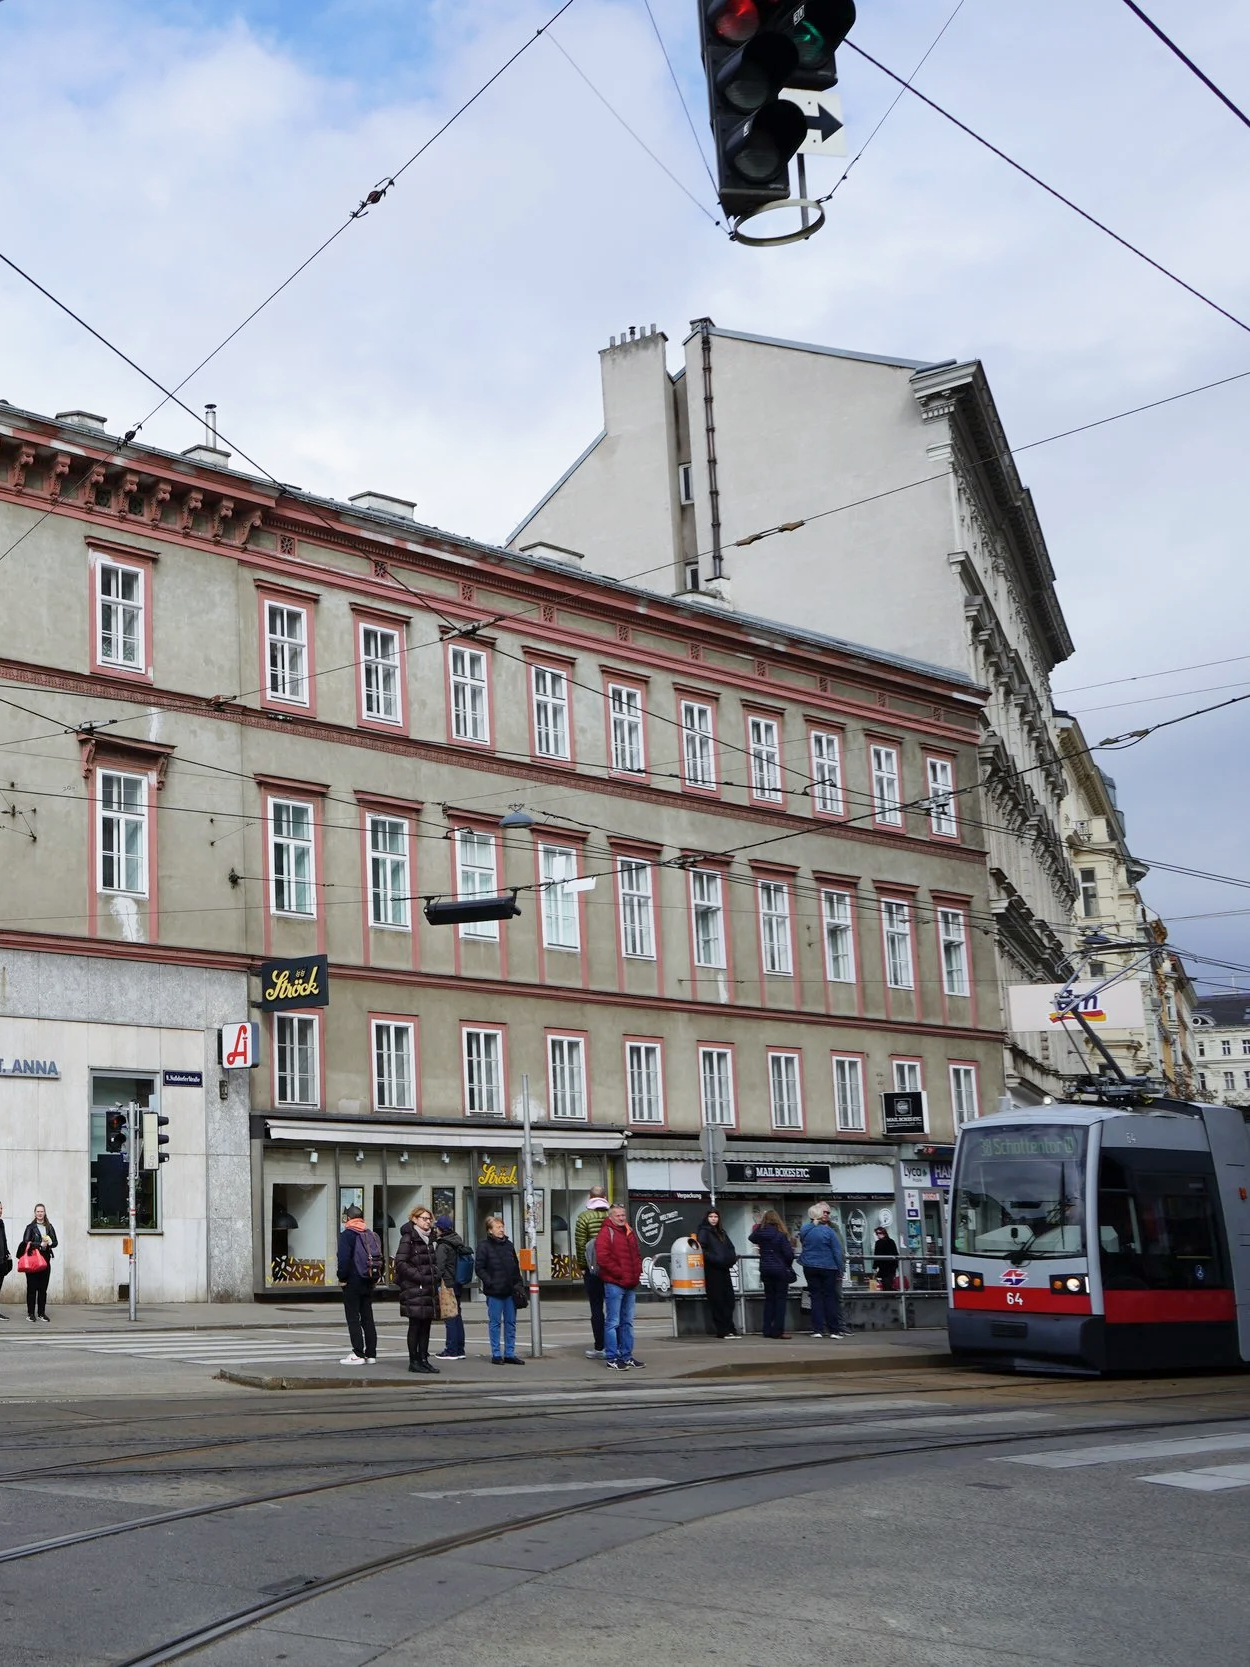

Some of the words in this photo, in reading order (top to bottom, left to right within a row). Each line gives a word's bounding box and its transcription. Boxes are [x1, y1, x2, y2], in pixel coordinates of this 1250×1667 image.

[265, 966, 319, 1001] Ströck
[12, 1059, 59, 1076] ANNA
[478, 1163, 518, 1185] Ströck
[756, 1167, 774, 1177] MAIL
[775, 1167, 795, 1177] BOXES
[904, 1165, 922, 1179] Lyca
[1006, 1292, 1023, 1306] 64
